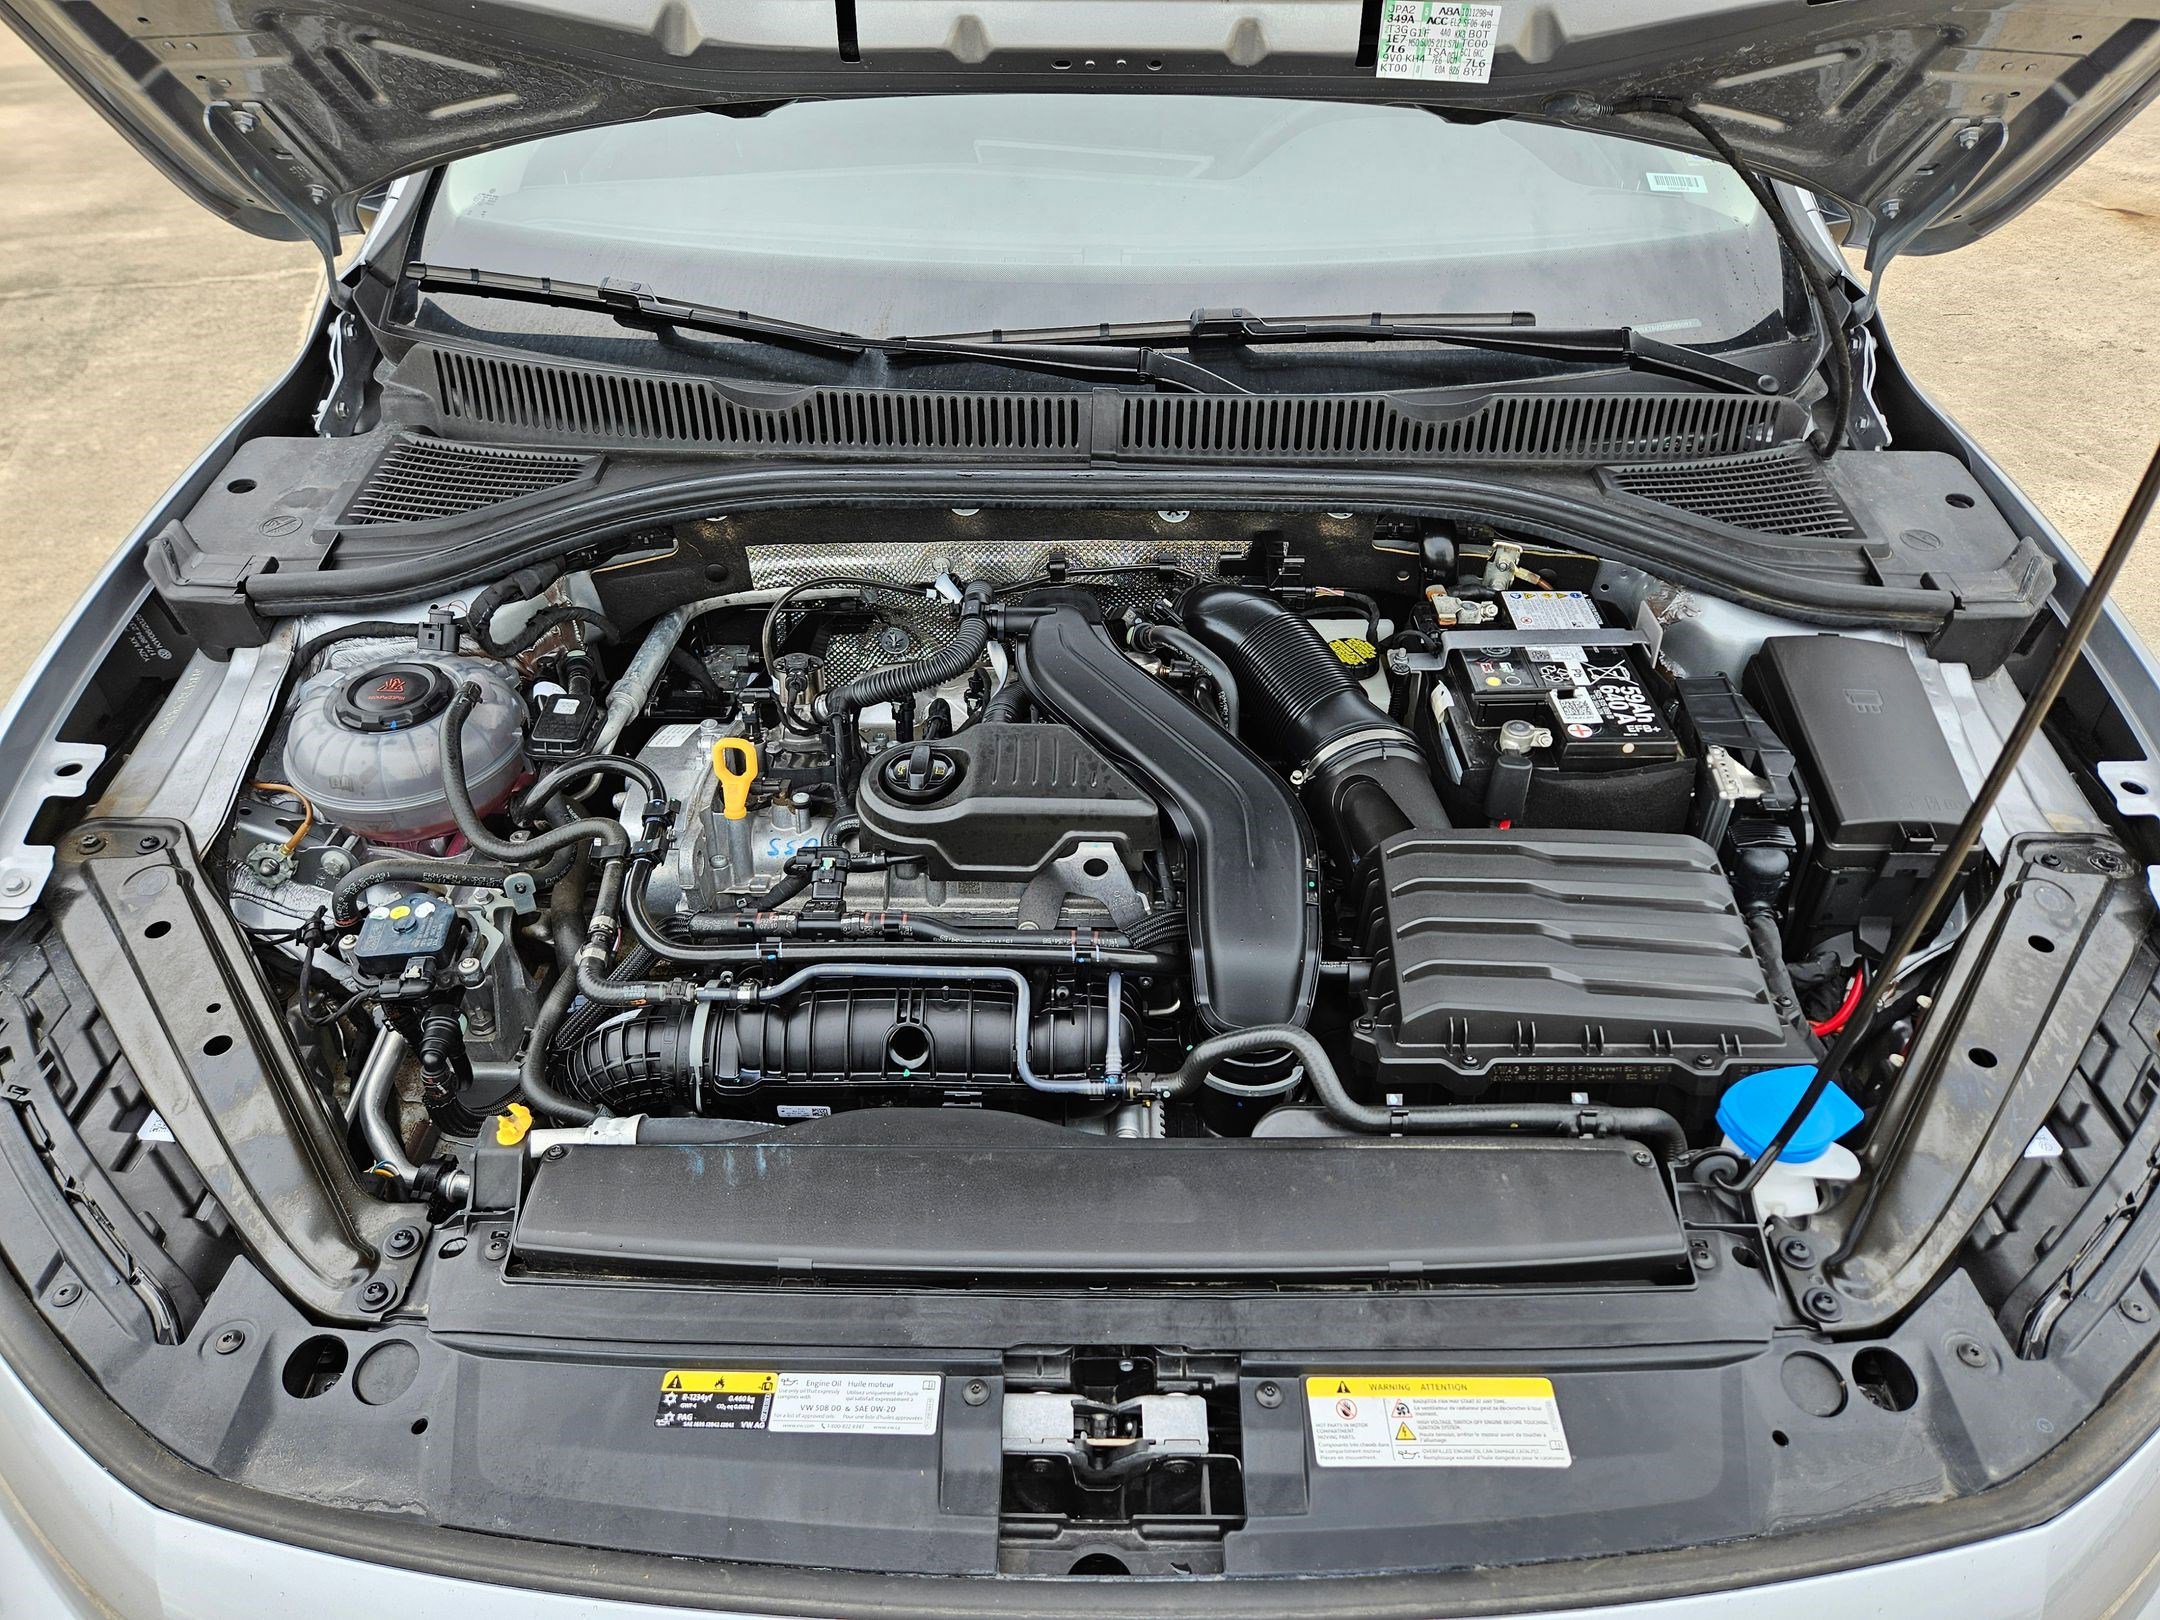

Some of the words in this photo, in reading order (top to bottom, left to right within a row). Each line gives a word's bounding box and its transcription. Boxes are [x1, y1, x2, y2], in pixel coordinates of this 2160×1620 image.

[1388, 5, 1416, 14] JPA2
[1387, 14, 1415, 24] 349A
[1426, 17, 1448, 25] ACC
[1388, 25, 1409, 34] T3G
[1410, 27, 1430, 38] G1F
[1386, 34, 1407, 43] 1E7
[1385, 45, 1406, 54] 7L6
[1427, 47, 1447, 57] 1SA
[1466, 58, 1486, 68] 7L6
[1463, 67, 1483, 77] 8Y1
[1600, 685, 1630, 711] 640
[1621, 686, 1656, 723] 59Ah
[1613, 712, 1637, 725] A
[1626, 724, 1662, 734] EFB+
[806, 1379, 831, 1389] Engine
[1369, 1383, 1411, 1391] WARNING
[1420, 1383, 1468, 1391] ATTENTION
[681, 1393, 714, 1404] R-1234yf
[815, 1404, 829, 1412] 508
[677, 1413, 694, 1421] PAG
[740, 1421, 754, 1429] VW
